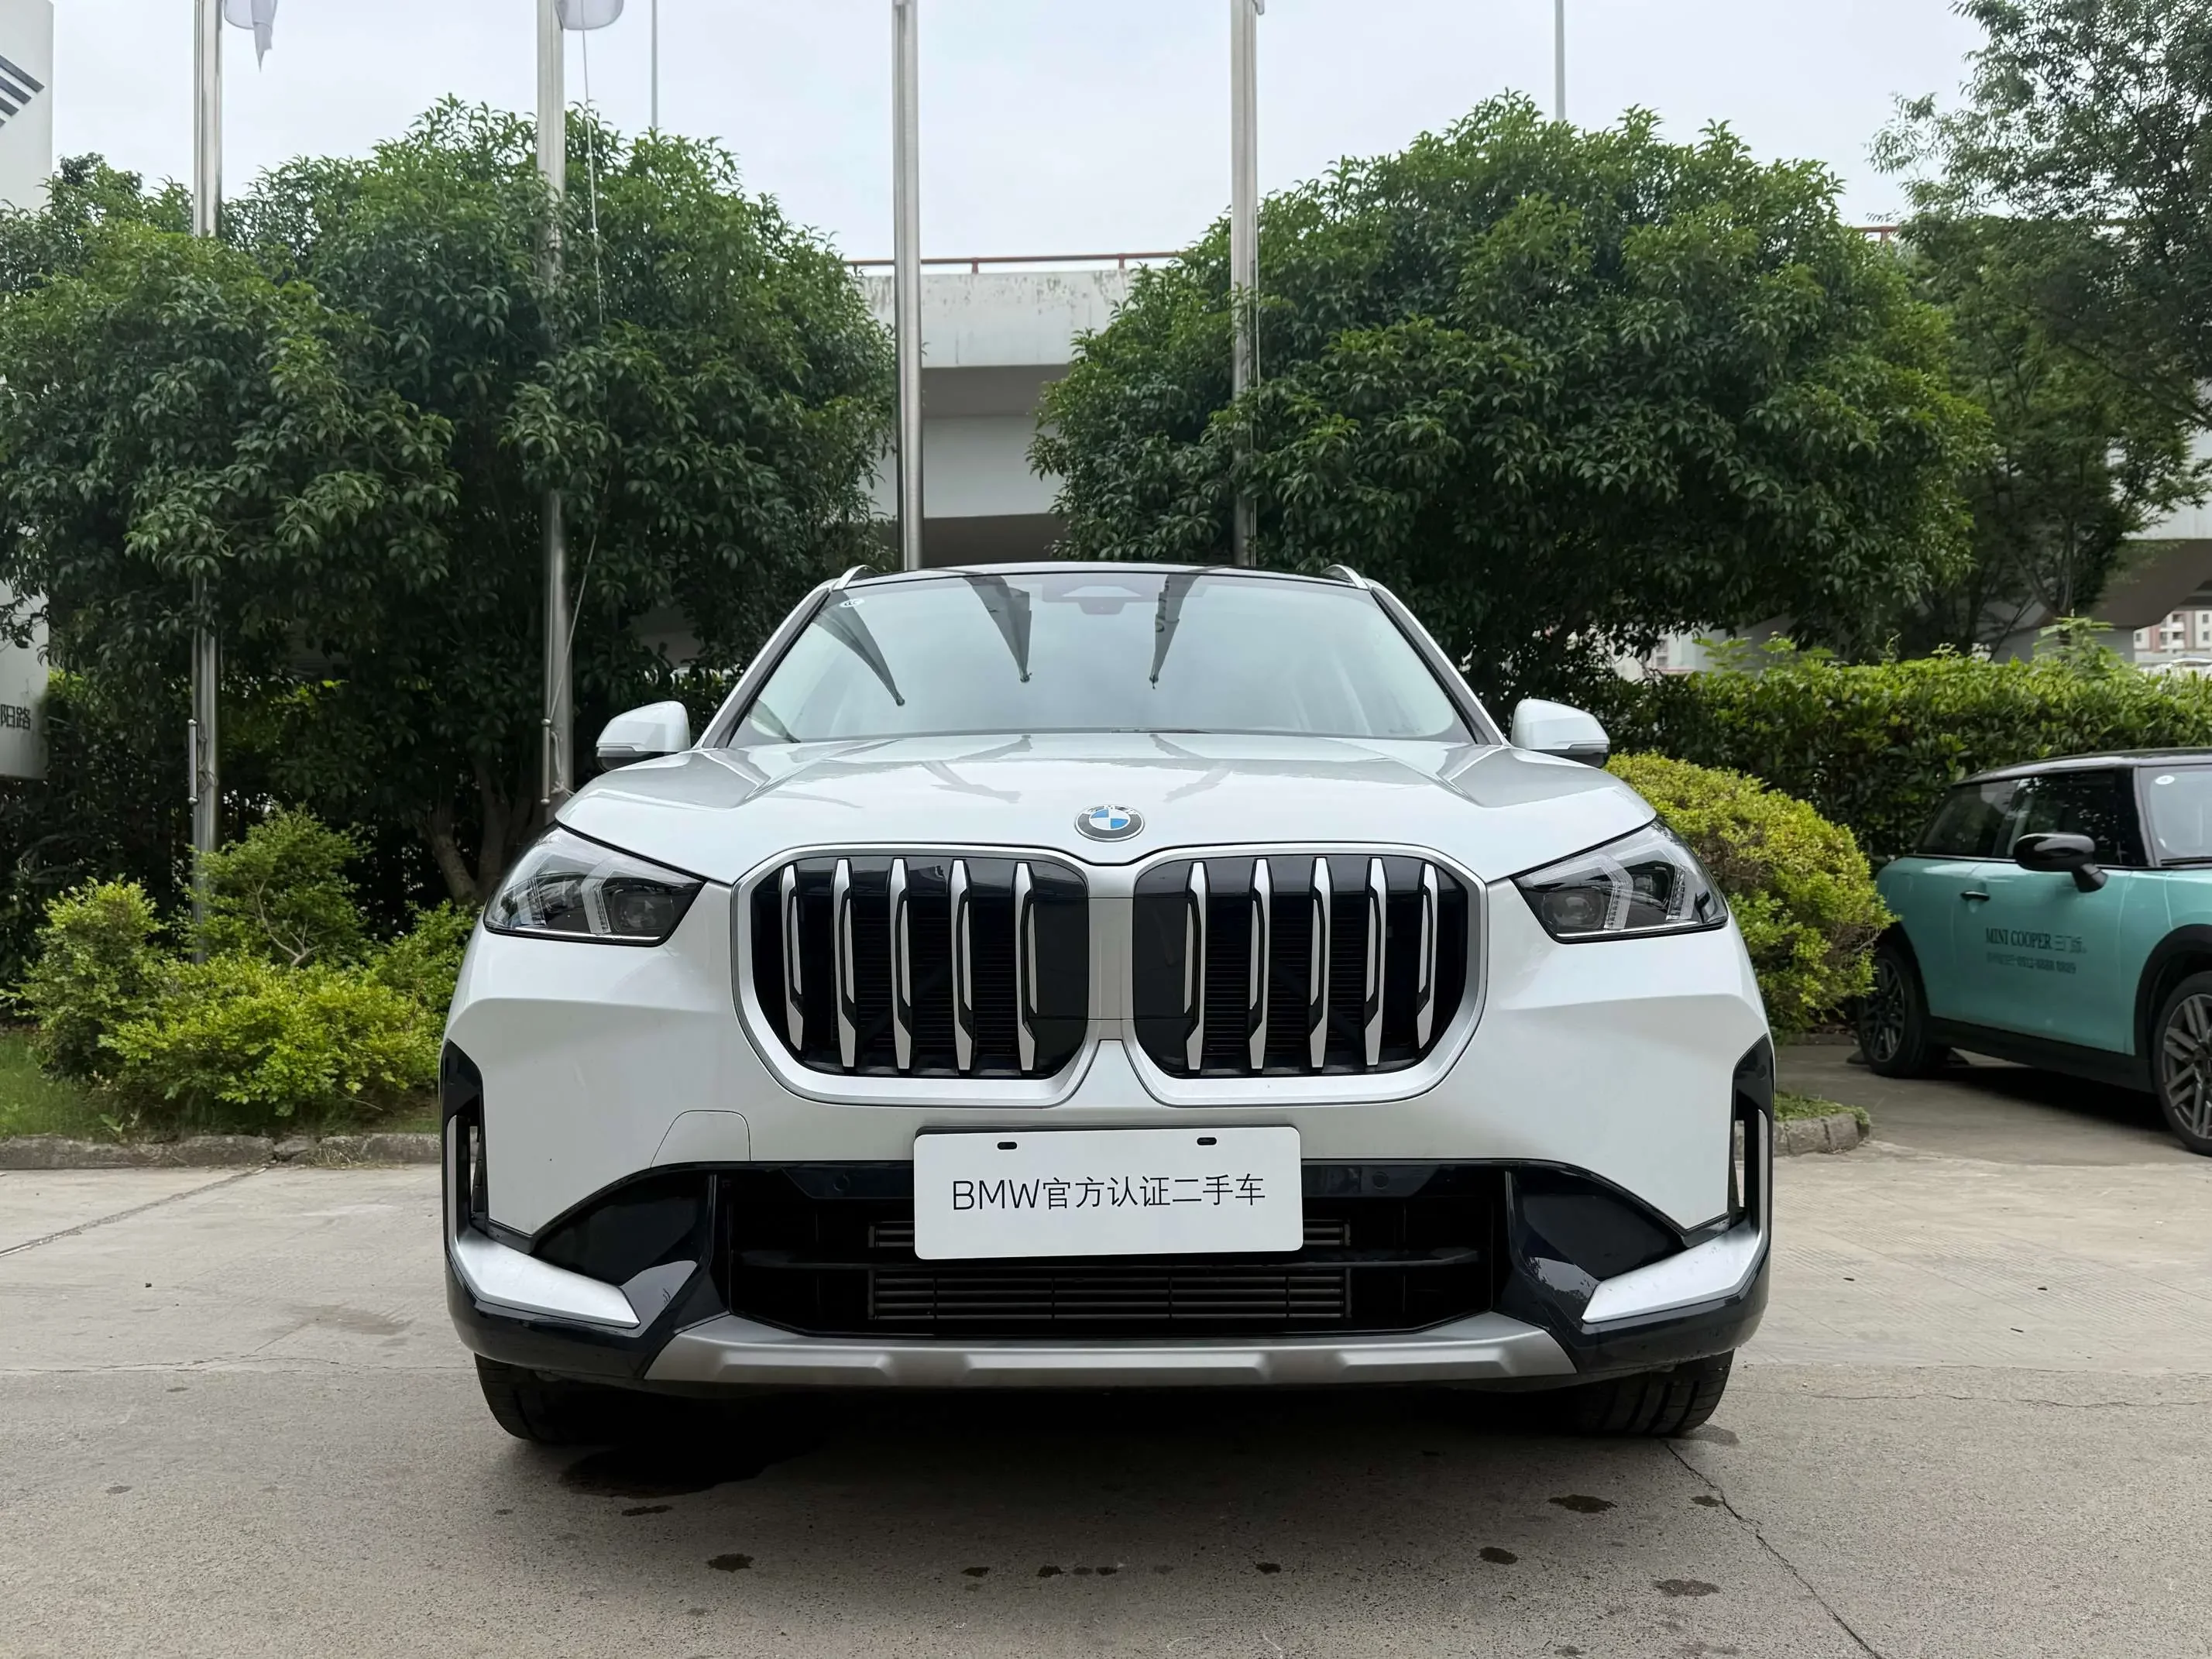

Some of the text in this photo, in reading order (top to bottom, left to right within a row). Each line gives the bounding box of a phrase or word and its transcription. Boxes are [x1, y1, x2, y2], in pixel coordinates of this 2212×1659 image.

[0, 703, 31, 731] 阳路
[1986, 927, 2008, 945] MINI
[2011, 930, 2052, 950] COOPER
[953, 1173, 1266, 1210] BMW官方认证二手车
